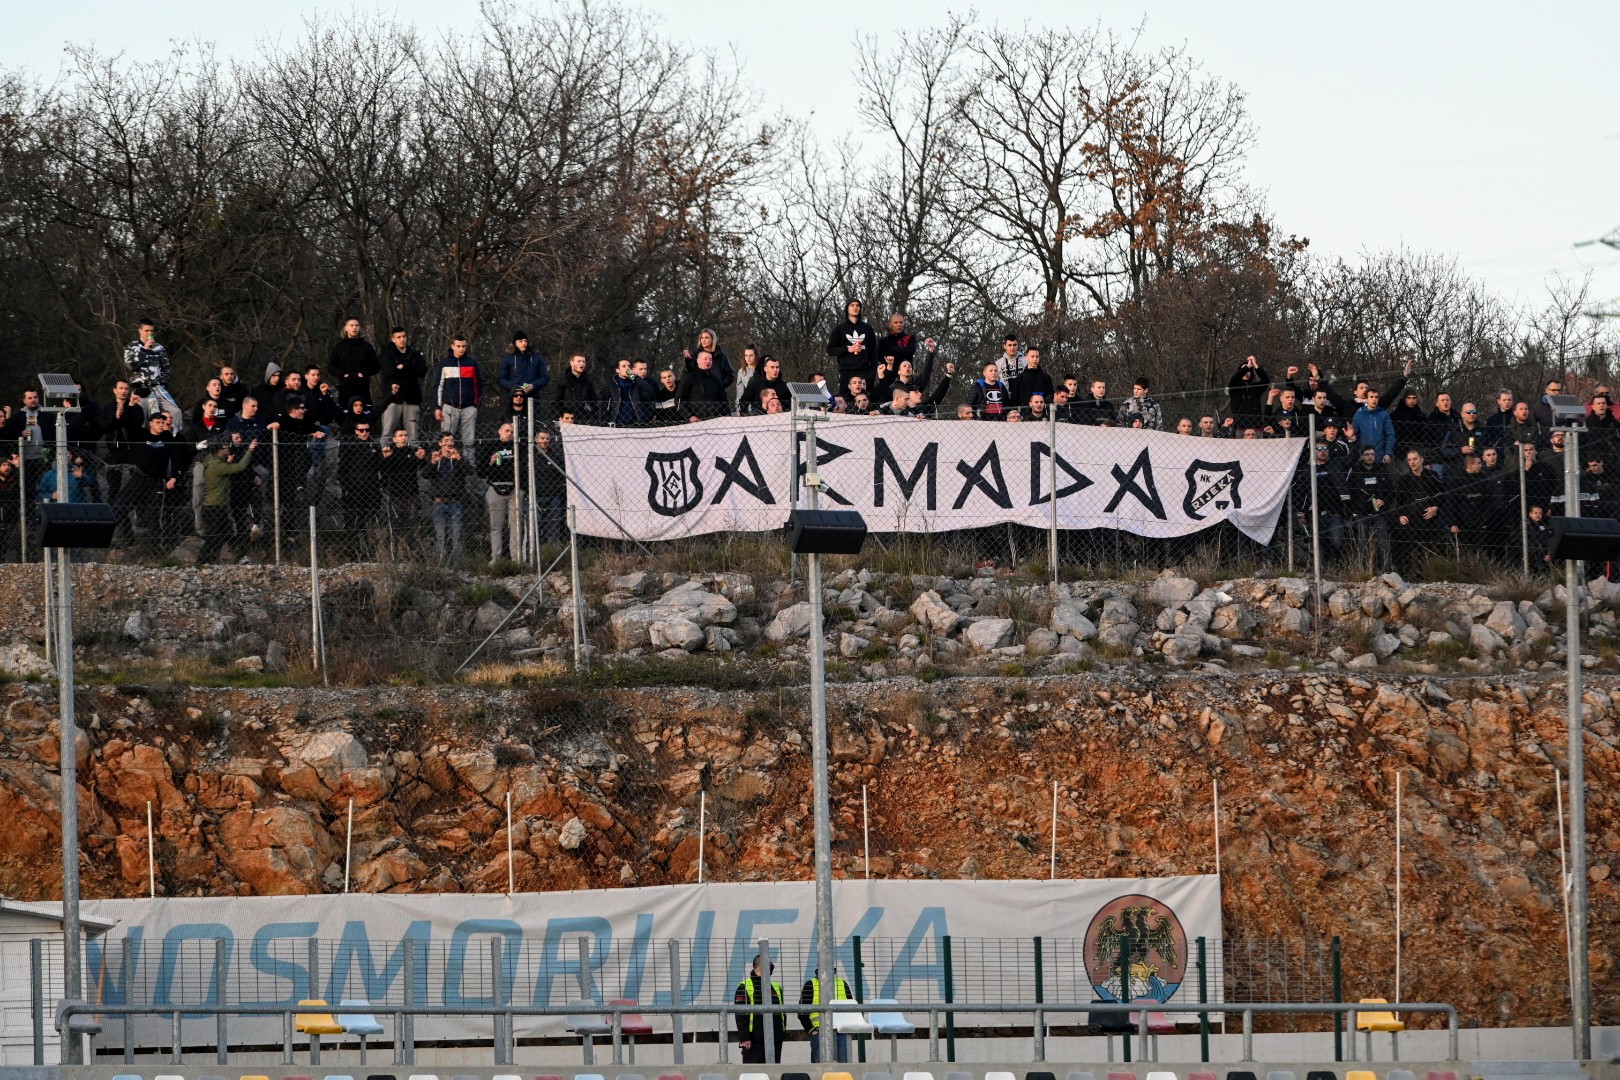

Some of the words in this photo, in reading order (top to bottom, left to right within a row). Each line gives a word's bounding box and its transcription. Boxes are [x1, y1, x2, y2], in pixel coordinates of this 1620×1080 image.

[711, 432, 1168, 521] ARMADA
[1191, 473, 1235, 510] RIJEKA
[1200, 474, 1212, 484] NK
